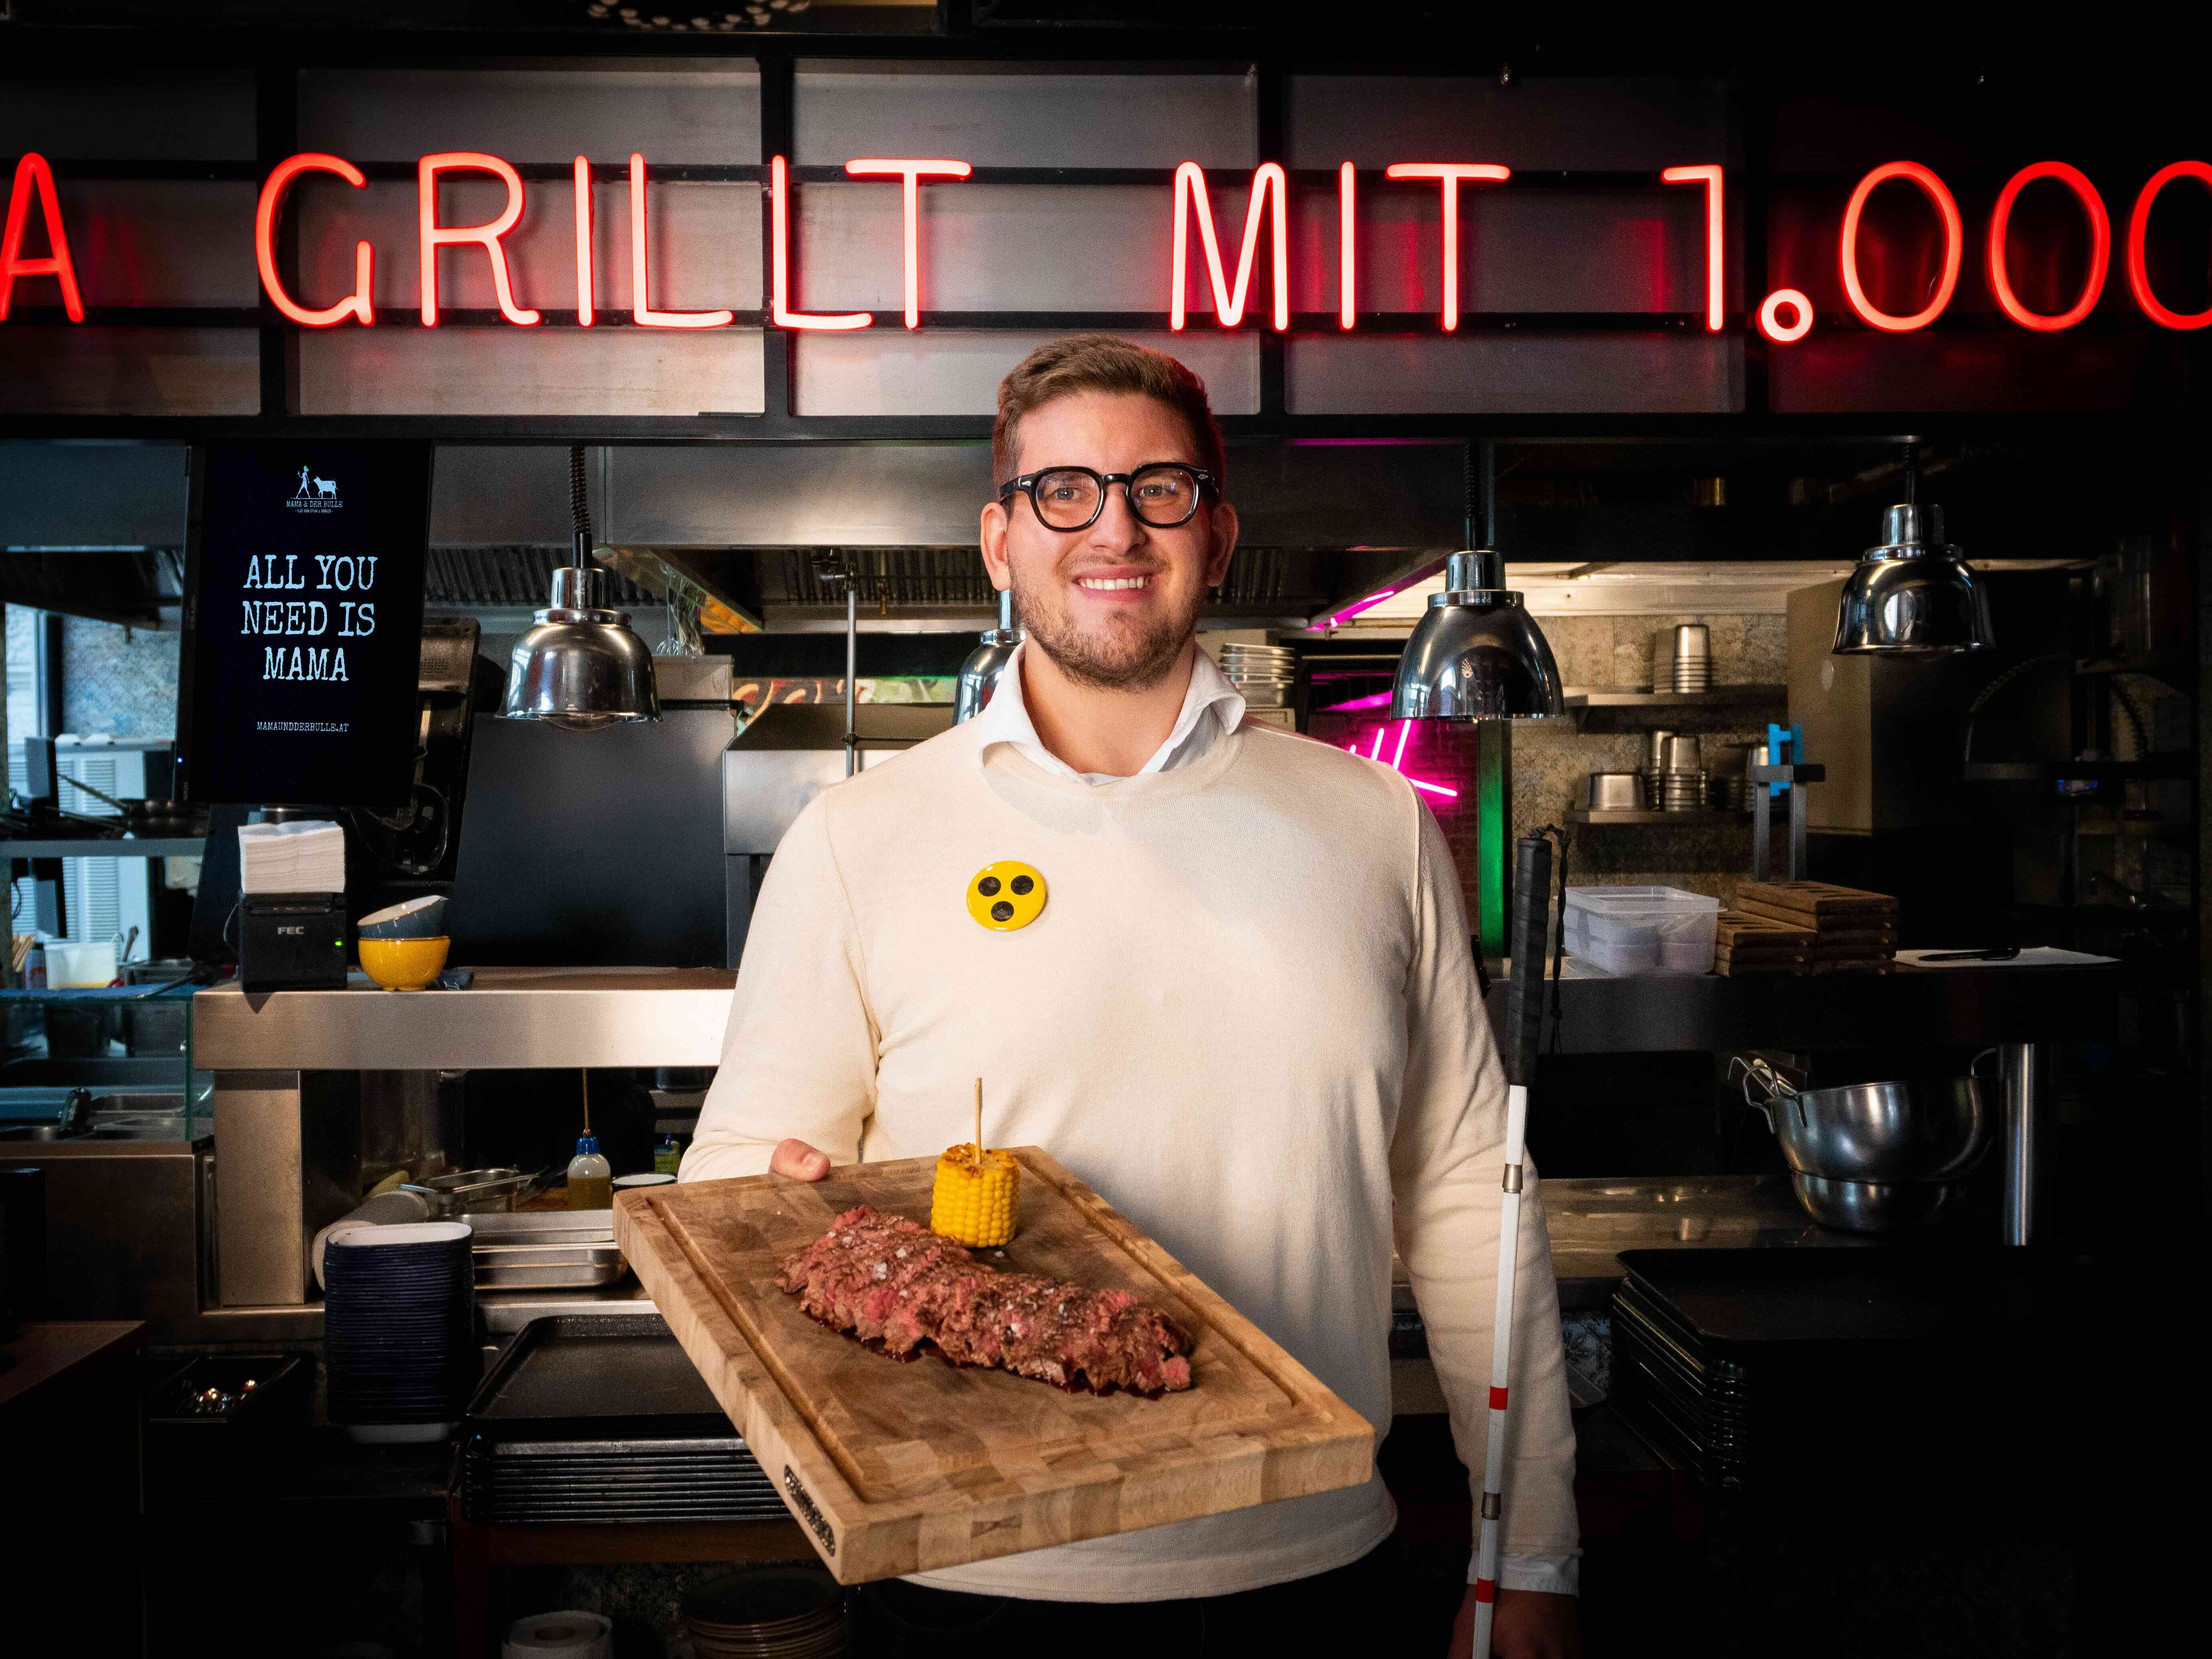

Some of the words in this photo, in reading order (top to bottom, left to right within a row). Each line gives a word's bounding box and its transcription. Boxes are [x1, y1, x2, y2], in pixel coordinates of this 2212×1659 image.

[255, 152, 973, 332] GRILLT
[1170, 160, 1511, 332] MIT
[243, 554, 305, 589] ALL
[315, 555, 378, 591] YOU
[241, 600, 328, 635] NEED
[338, 601, 375, 637] IS
[263, 646, 349, 682] MAMA
[257, 721, 349, 732] MAMAUNDDERBULLE.AT
[277, 926, 304, 934] FEC
